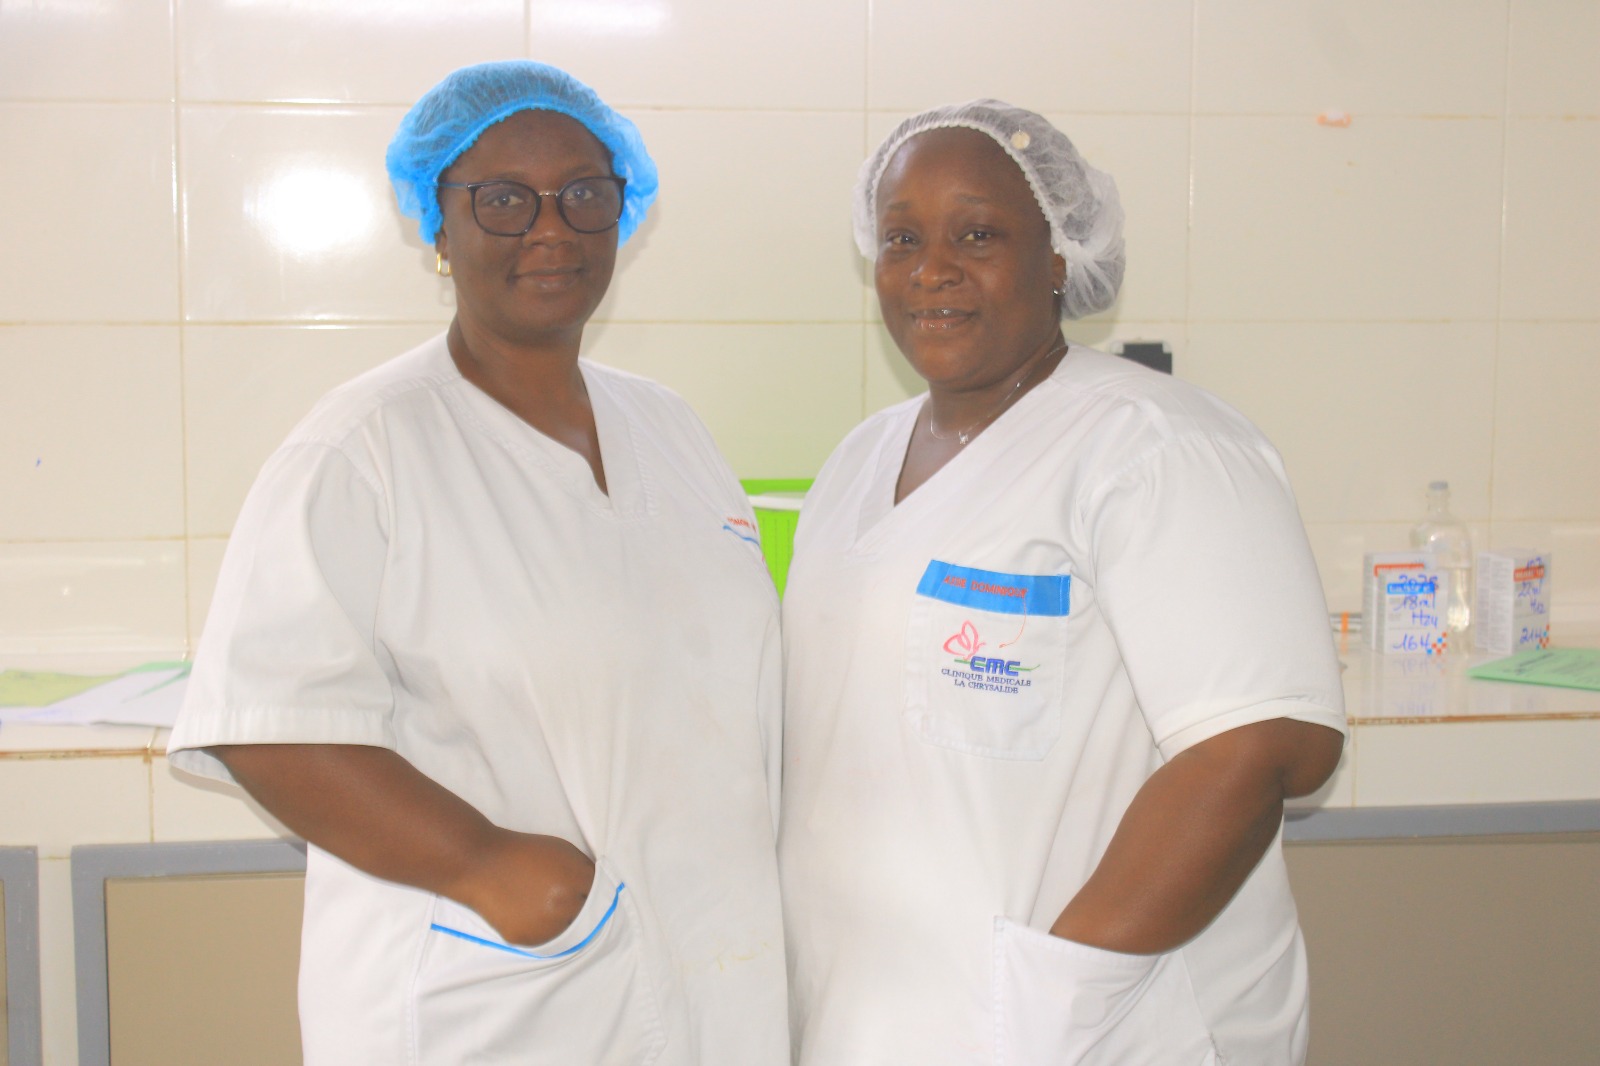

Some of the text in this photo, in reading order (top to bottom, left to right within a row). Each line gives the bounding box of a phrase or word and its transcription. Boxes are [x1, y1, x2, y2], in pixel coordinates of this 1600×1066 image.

[941, 668, 1031, 687] CLINIQUE MEDICALE
[954, 679, 1019, 694] LA CHRYSALIDE
